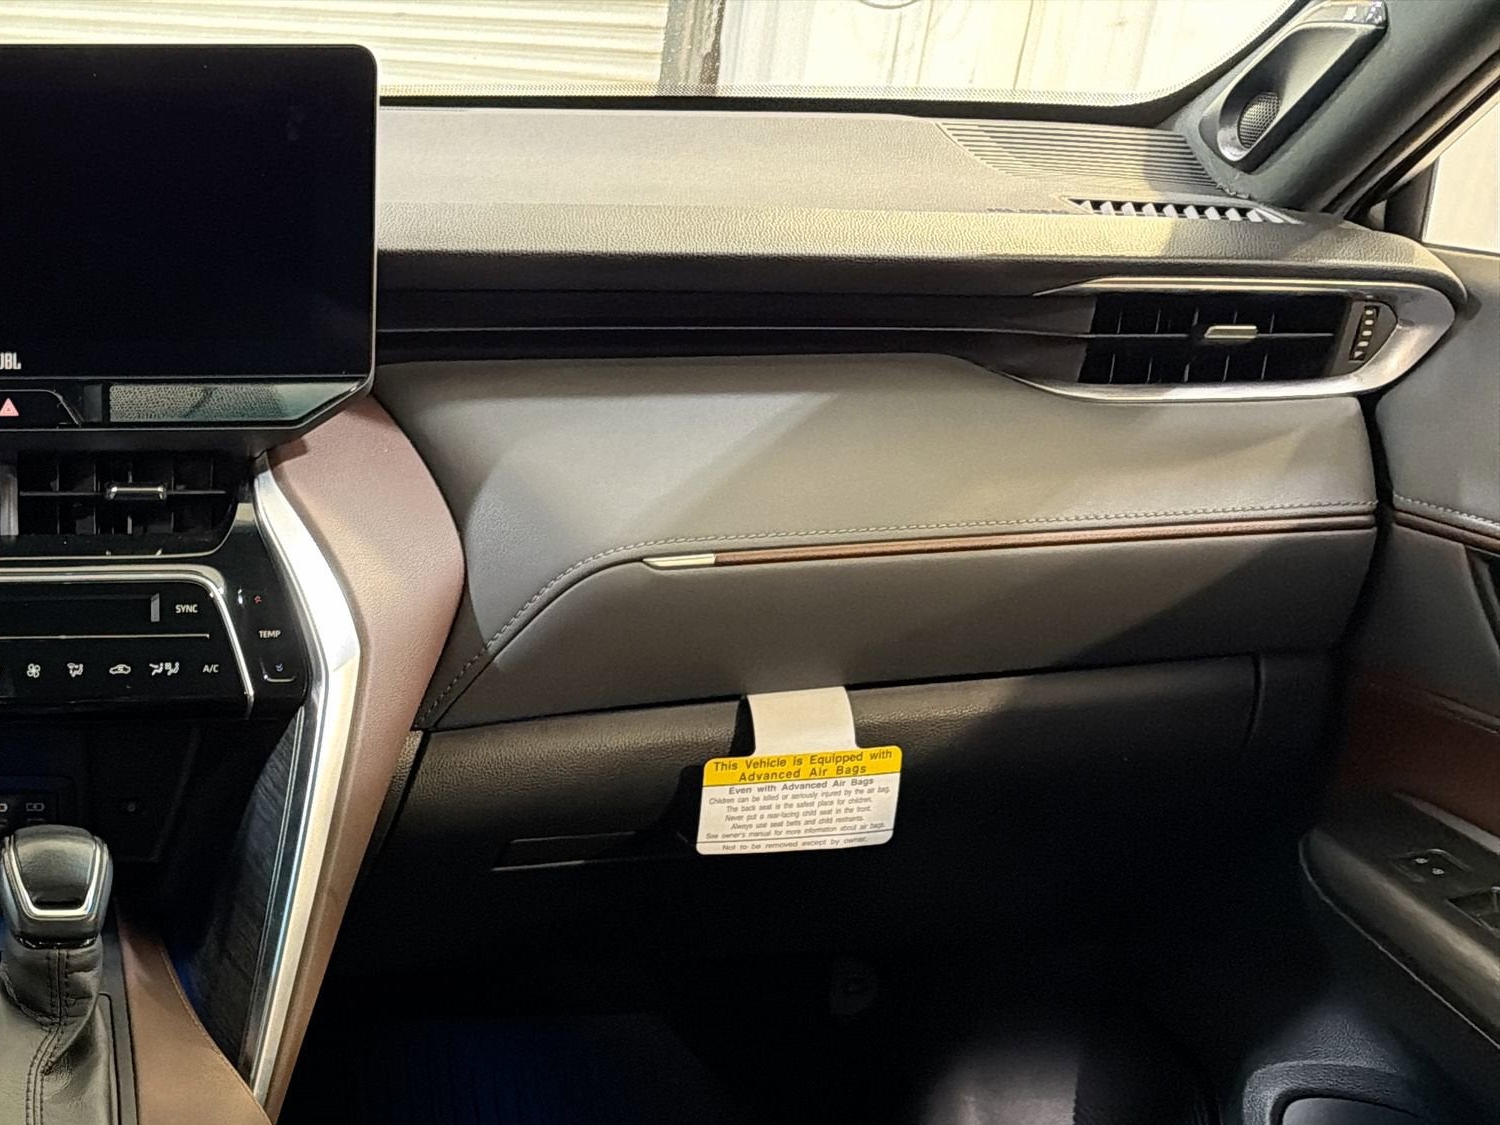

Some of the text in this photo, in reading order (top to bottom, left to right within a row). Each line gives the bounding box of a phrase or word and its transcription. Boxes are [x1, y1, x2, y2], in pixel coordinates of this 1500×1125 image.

[175, 604, 198, 614] SYNC
[258, 630, 281, 639] TEMP
[202, 664, 220, 673] A/C
[714, 749, 892, 772] This Vehicle is Equipped with
[739, 765, 867, 782] Advanced Air Bags
[728, 786, 752, 795] Even
[757, 785, 776, 793] with
[781, 781, 828, 791] Advanced
[851, 778, 874, 787] Bags
[708, 797, 735, 805] Children
